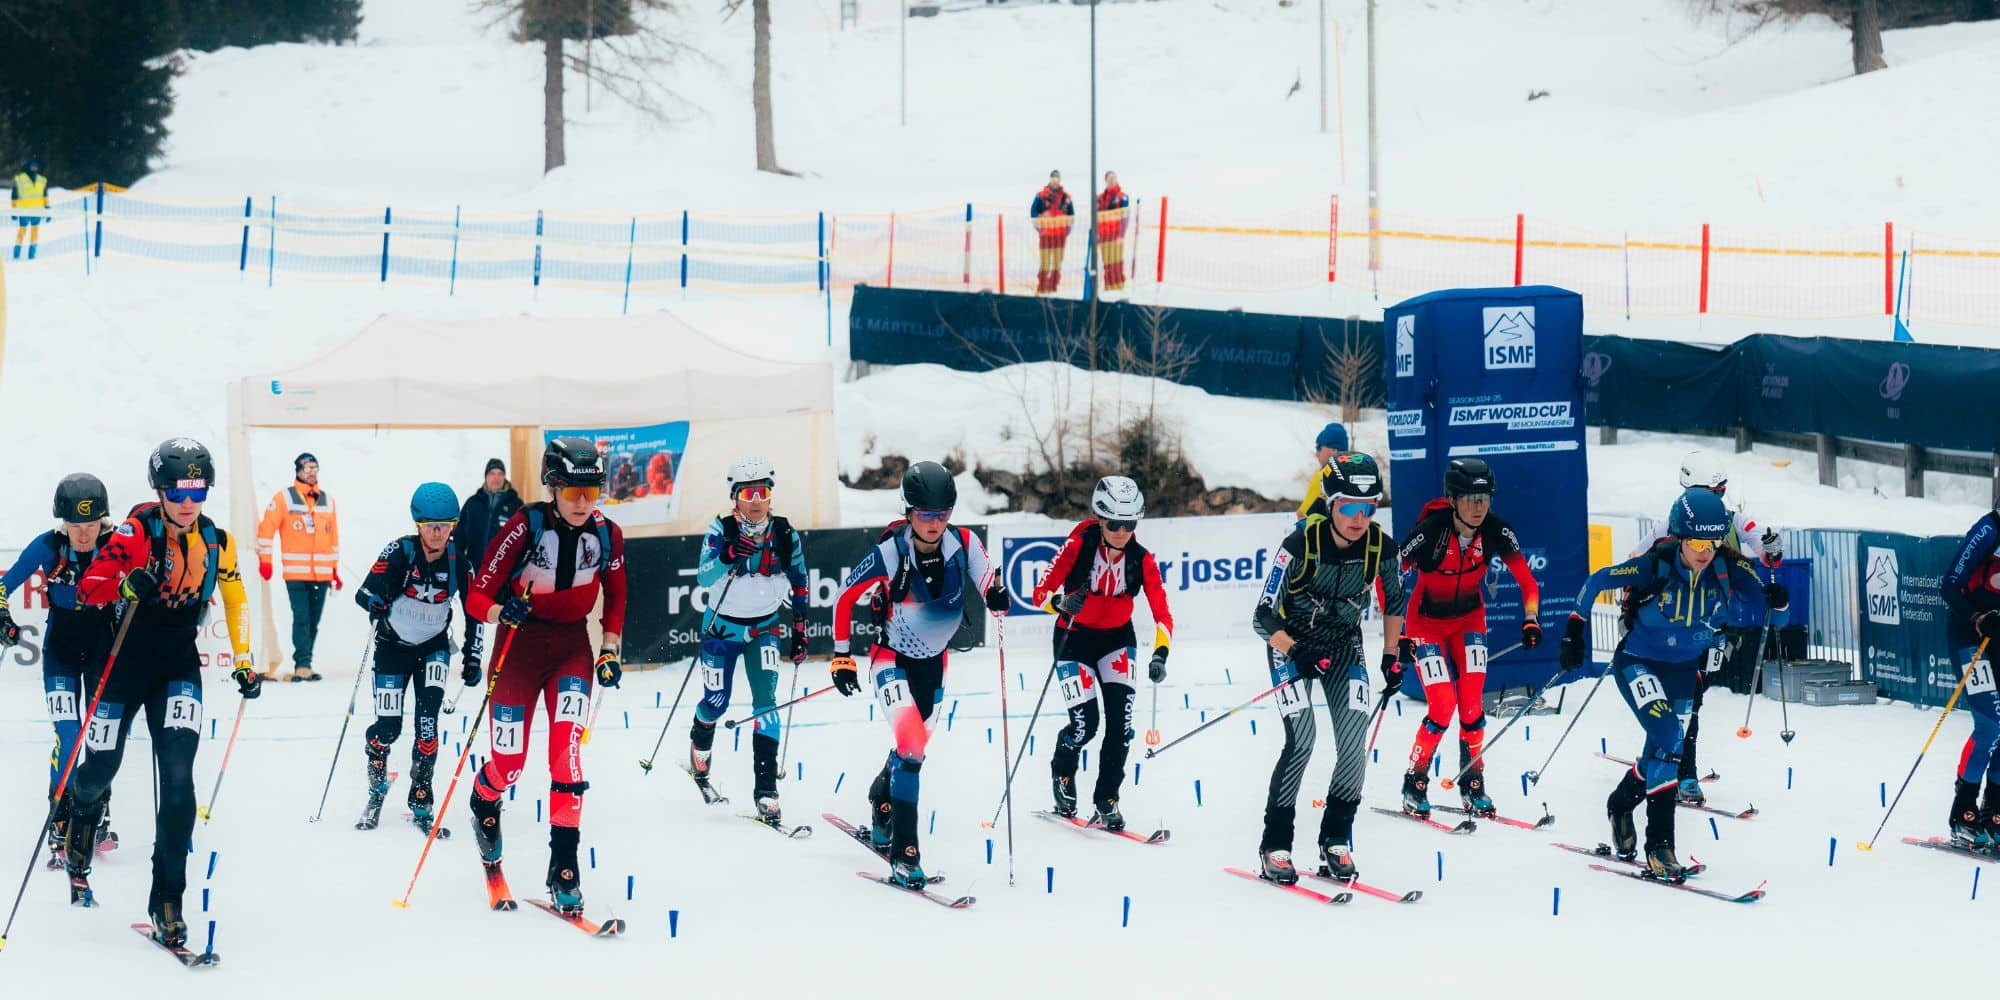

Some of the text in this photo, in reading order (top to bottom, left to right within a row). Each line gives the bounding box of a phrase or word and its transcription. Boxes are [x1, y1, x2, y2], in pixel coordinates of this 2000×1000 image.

[1489, 346, 1534, 366] ISMF
[1453, 405, 1567, 421] ISMF WORLD CUP
[1695, 523, 1725, 532] LIVIGNO
[1179, 548, 1267, 591] josef
[1868, 594, 1898, 617] ISMF
[1902, 606, 1934, 622] Federation
[1471, 648, 1486, 667] 1.1
[427, 665, 448, 683] 10.1
[1424, 659, 1444, 679] 1.1
[1970, 663, 1990, 687] 3.1
[883, 683, 904, 707] 8.1
[1280, 683, 1301, 706] 4.1
[1635, 677, 1658, 698] 6.1
[49, 696, 73, 714] 14.1
[173, 700, 195, 721] 5.1
[378, 692, 400, 711] 10.1
[561, 695, 583, 717] 2.1
[88, 722, 111, 743] 5.1
[496, 726, 515, 748] 2.1
